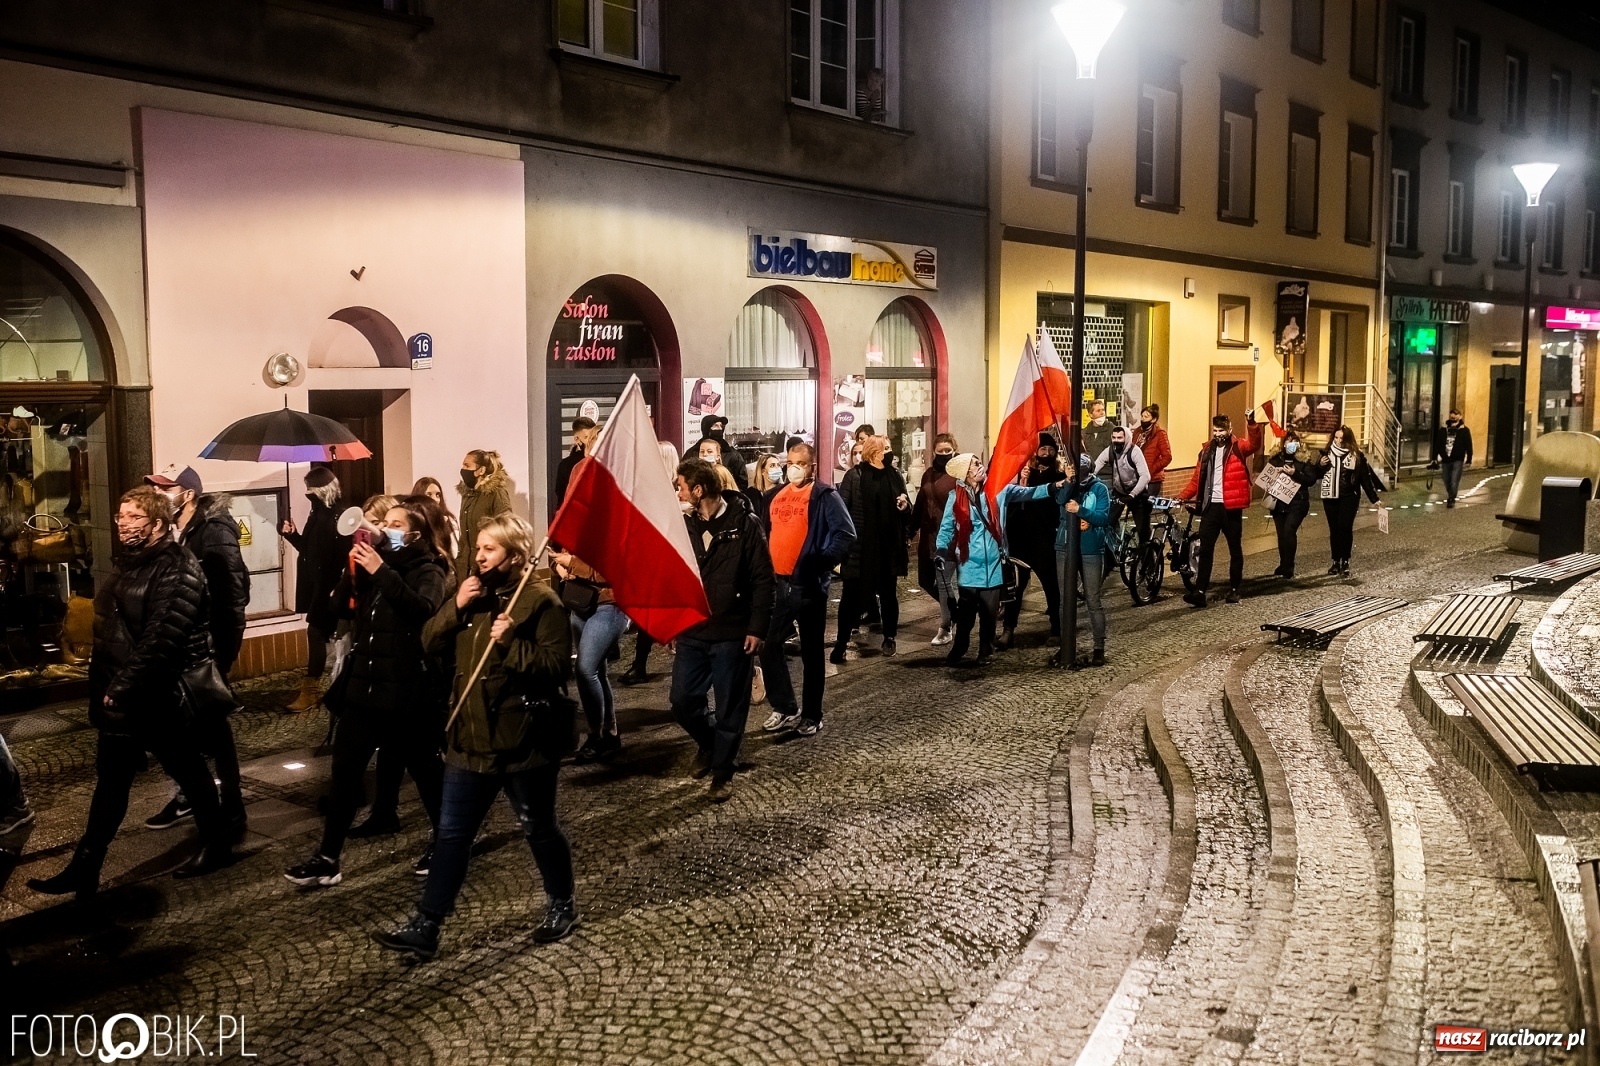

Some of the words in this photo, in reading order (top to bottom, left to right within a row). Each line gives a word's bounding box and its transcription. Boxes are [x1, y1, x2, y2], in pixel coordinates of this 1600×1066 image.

[852, 253, 905, 283] home
[562, 295, 609, 318] Salon
[572, 314, 624, 350] firan
[416, 339, 429, 353] 16
[553, 340, 559, 361] i
[565, 338, 616, 361] zasłon
